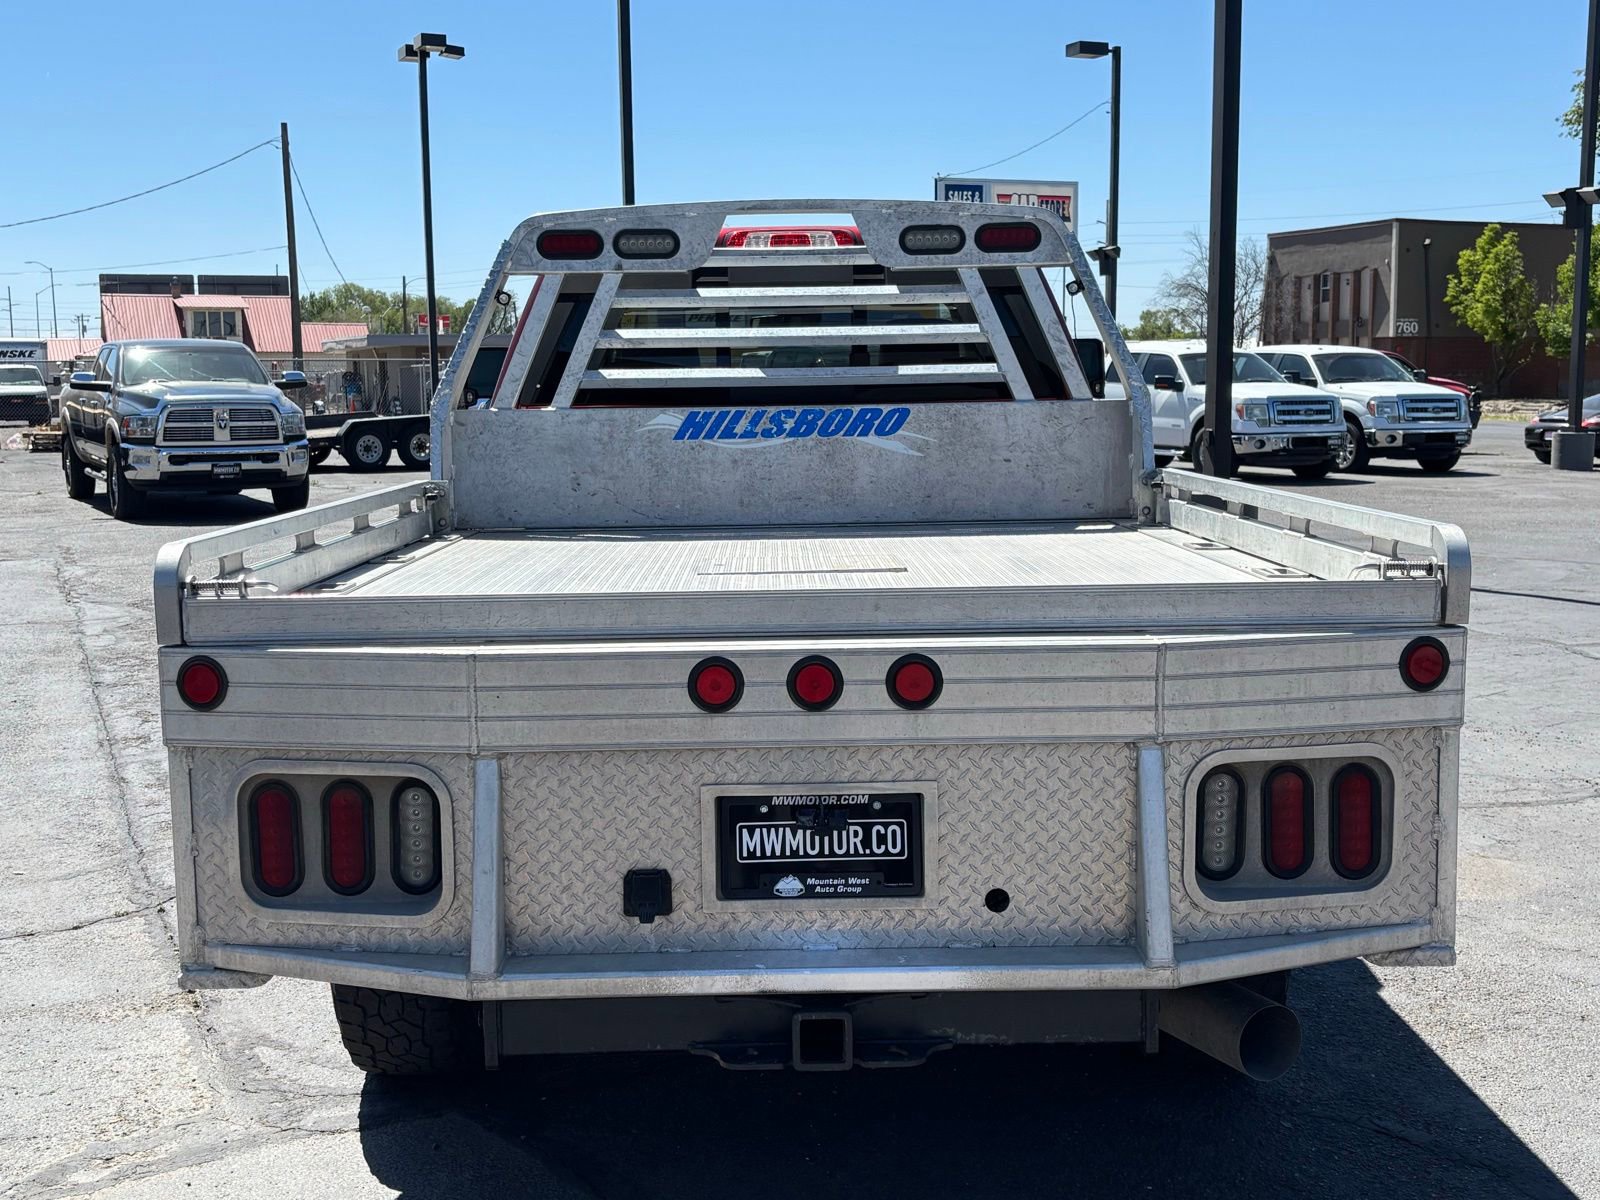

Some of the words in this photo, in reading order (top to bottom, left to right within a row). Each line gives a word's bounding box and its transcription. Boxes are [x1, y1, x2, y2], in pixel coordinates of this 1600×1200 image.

[948, 190, 972, 202] SALES
[1397, 321, 1419, 334] 760
[0, 349, 37, 359] NSKE
[672, 406, 911, 441] HILLSBORO
[806, 878, 846, 886] Mountain
[848, 877, 870, 885] West
[814, 885, 835, 893] Auto
[837, 884, 862, 894] Group
